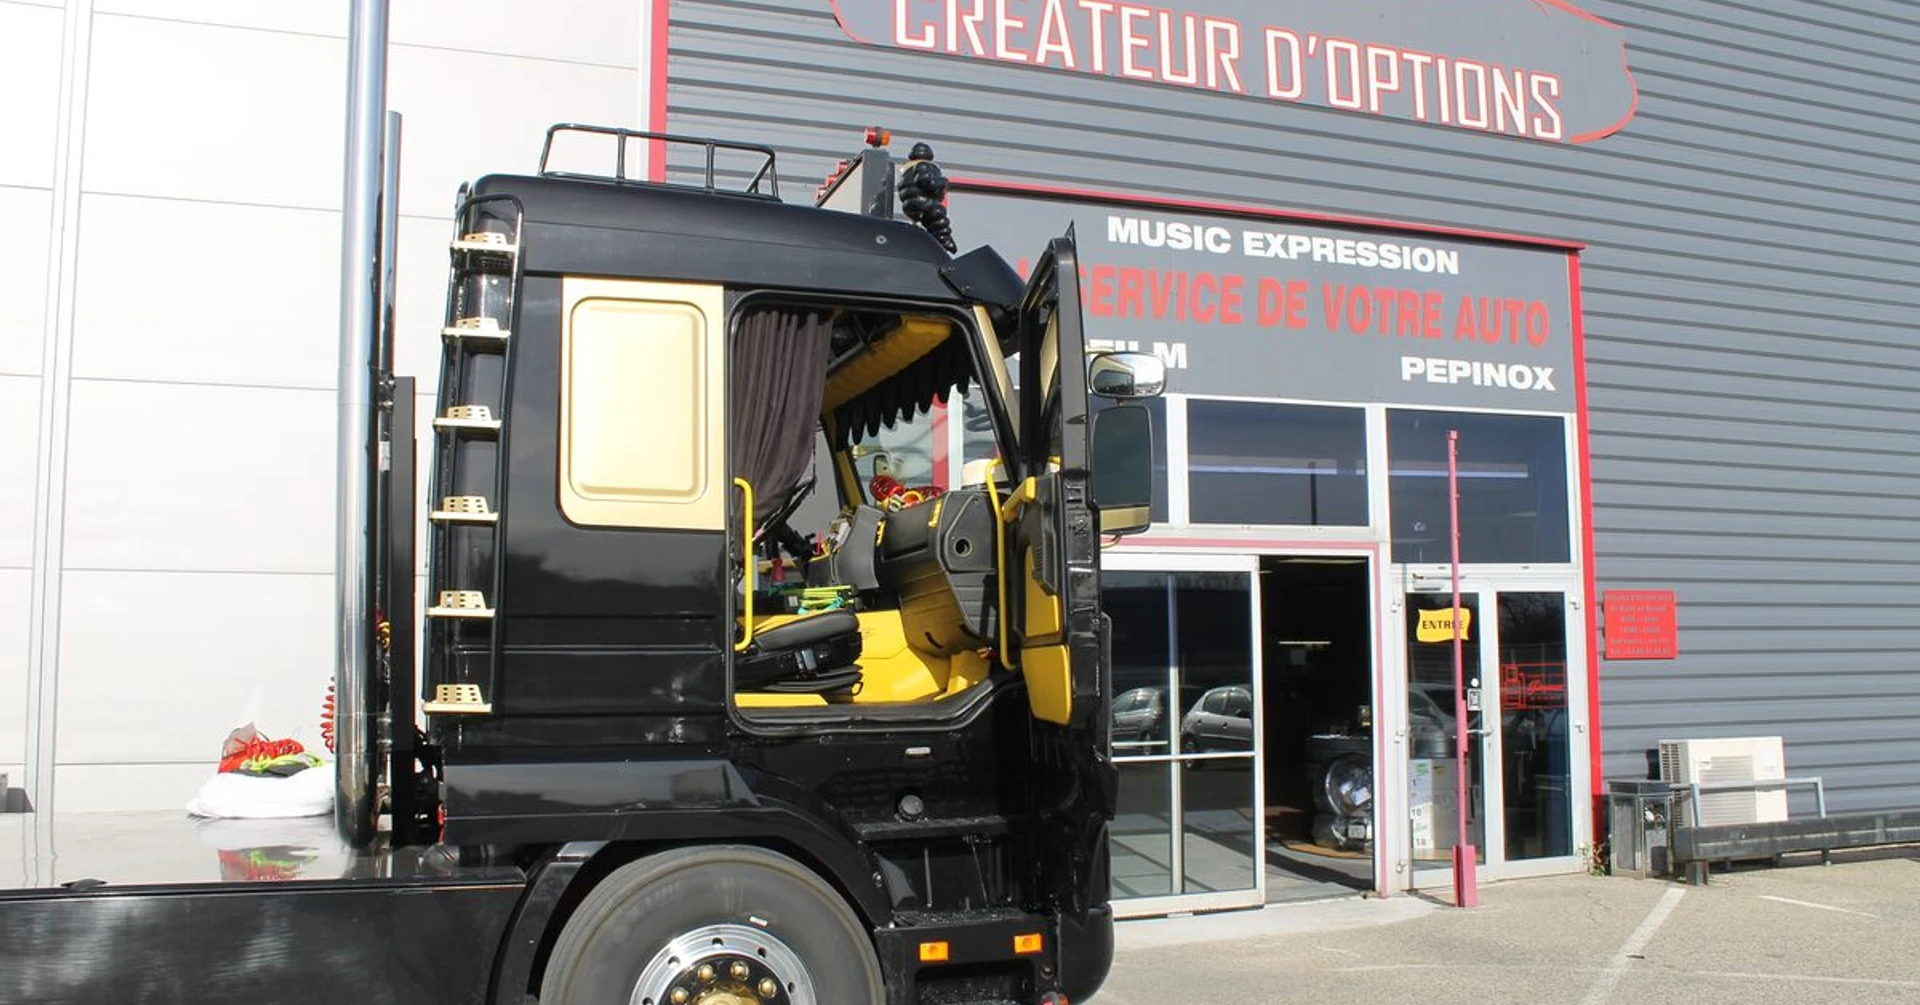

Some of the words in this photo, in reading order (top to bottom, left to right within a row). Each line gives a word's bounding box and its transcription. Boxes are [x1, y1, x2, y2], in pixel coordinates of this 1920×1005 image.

[893, 0, 1241, 94] CREATEUR
[1264, 27, 1563, 142] D'OPTIONS
[1107, 215, 1231, 253] MUSIC
[1243, 231, 1459, 275] EXPRESSION
[1079, 263, 1244, 325] ERVICE
[1256, 276, 1309, 330] DE
[1321, 281, 1444, 340] VOTRE
[1453, 295, 1551, 348] AUTO
[1400, 356, 1556, 391] PEPINOX
